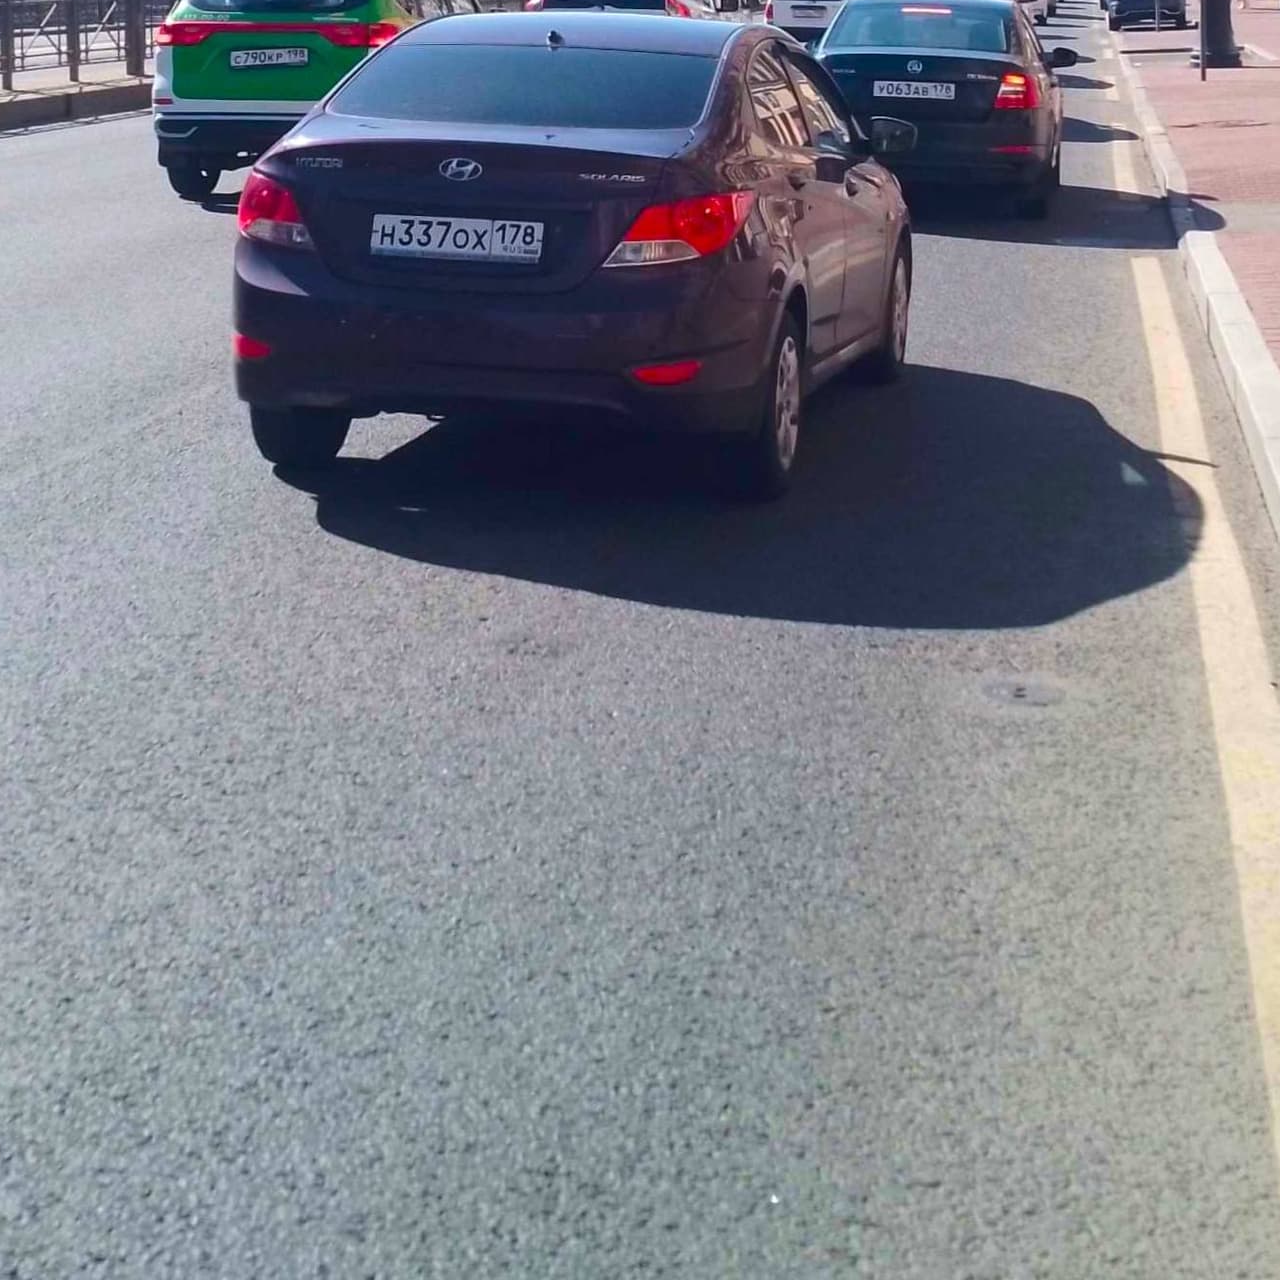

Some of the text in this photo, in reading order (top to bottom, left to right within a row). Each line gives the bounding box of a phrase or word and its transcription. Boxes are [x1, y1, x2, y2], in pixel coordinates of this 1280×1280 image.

[878, 82, 928, 97] У063АВ
[578, 172, 647, 183] SOLARIS
[380, 218, 537, 252] Н337ОХ 178
